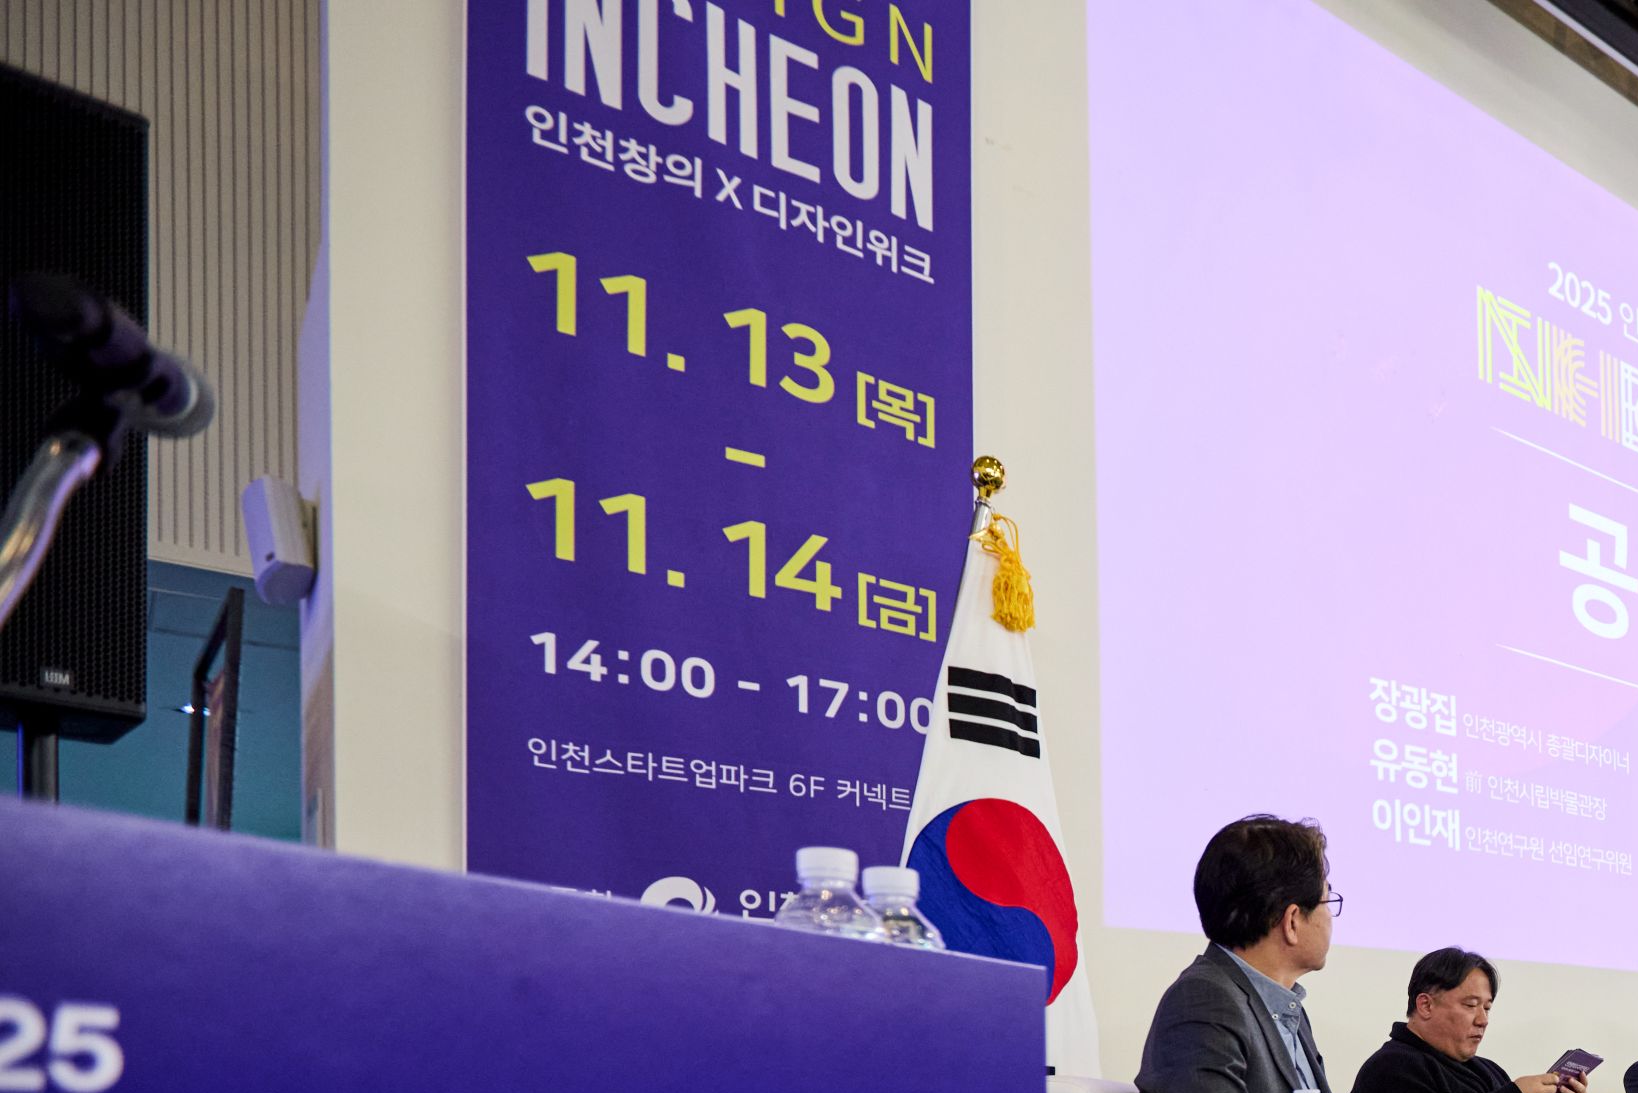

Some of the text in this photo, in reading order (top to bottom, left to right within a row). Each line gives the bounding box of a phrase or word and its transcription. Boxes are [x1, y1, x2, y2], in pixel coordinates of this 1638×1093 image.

[525, 0, 934, 233] INCHEON
[524, 104, 936, 285] 인천창의 X 디자인위크
[525, 251, 687, 374] 11.
[1546, 262, 1614, 327] 2025
[525, 477, 686, 590] 11.
[530, 631, 717, 699] 14:00
[786, 674, 934, 736] 17:00
[1368, 676, 1632, 776] 장광집 인천광역시 총괄디자이너
[526, 737, 778, 796] 인천스타트업파크
[787, 773, 827, 800] 6F
[1368, 738, 1459, 795] 유동현
[1487, 773, 1608, 822] 인천시립박물관장
[1371, 798, 1633, 877] 이인재 인천연구원 선임연구위원
